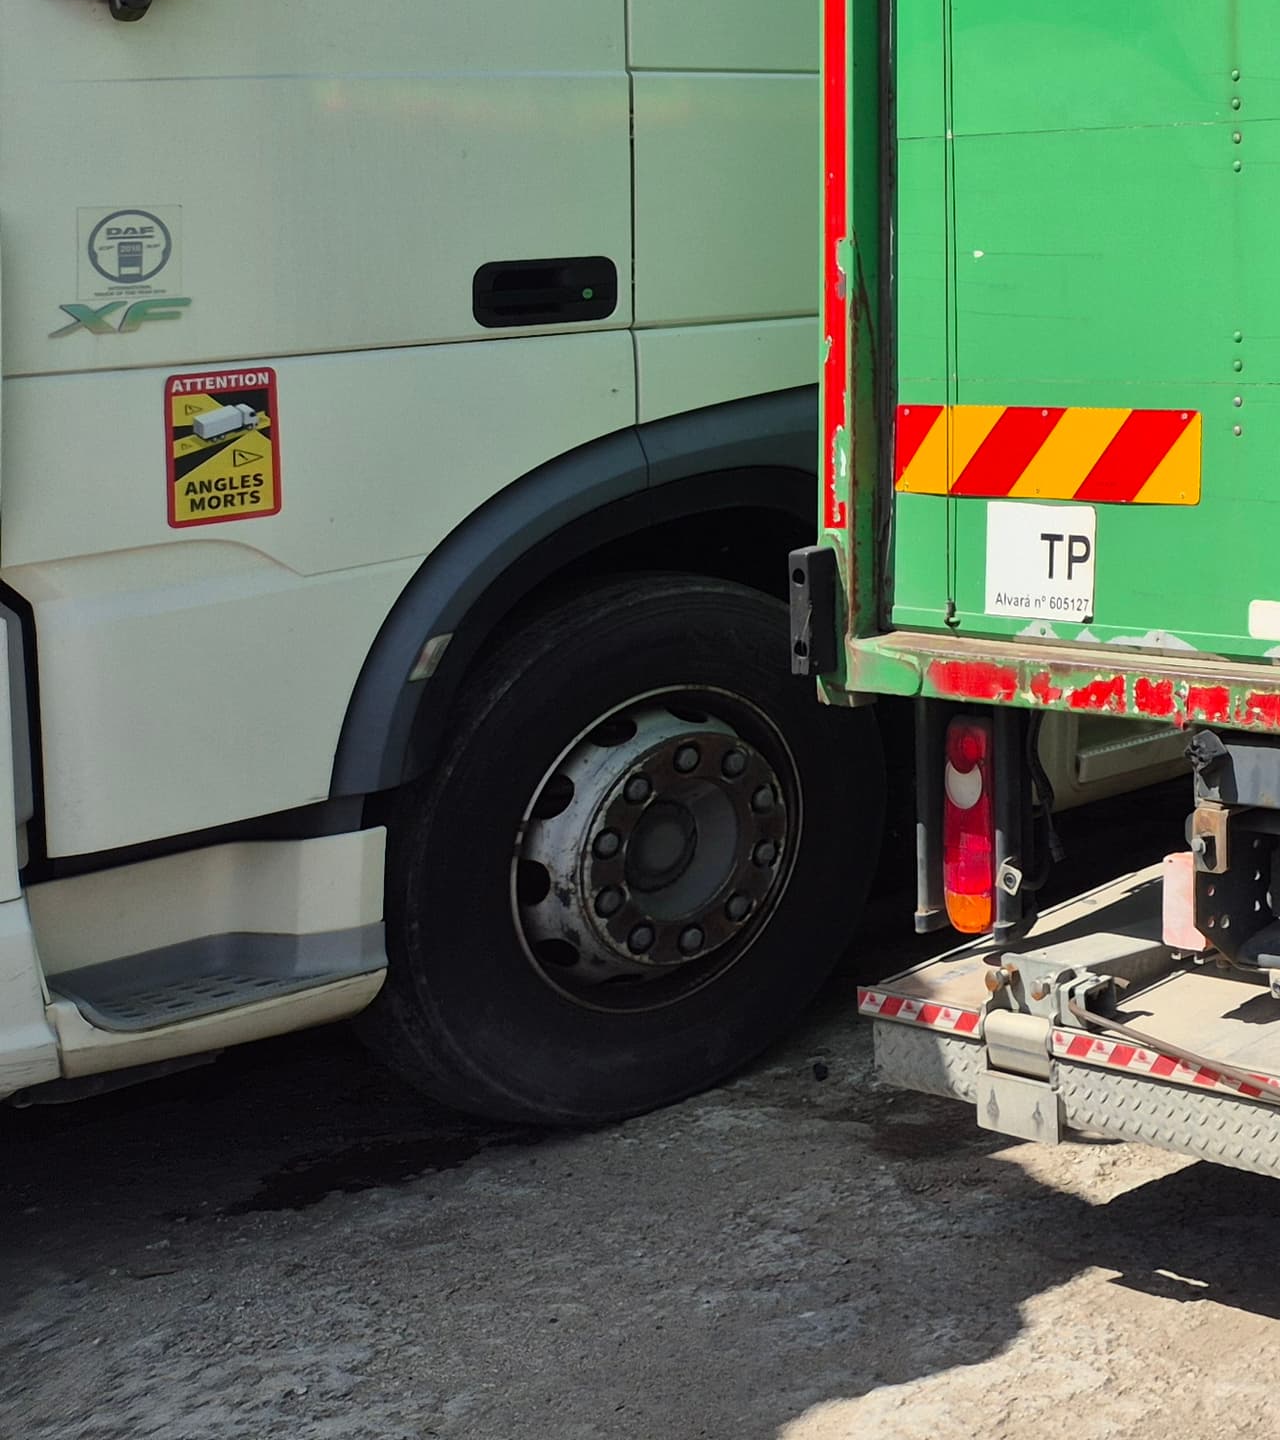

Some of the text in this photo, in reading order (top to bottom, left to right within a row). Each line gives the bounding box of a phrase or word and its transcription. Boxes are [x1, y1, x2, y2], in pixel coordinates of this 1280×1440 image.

[106, 226, 155, 236] DAF
[48, 297, 193, 339] XF
[171, 371, 270, 393] ATTENTION
[184, 472, 264, 496] ANGLES
[190, 490, 261, 512] MORTS
[1040, 533, 1091, 580] TP
[995, 592, 1031, 608] Alvará
[1049, 596, 1090, 612] 605127
